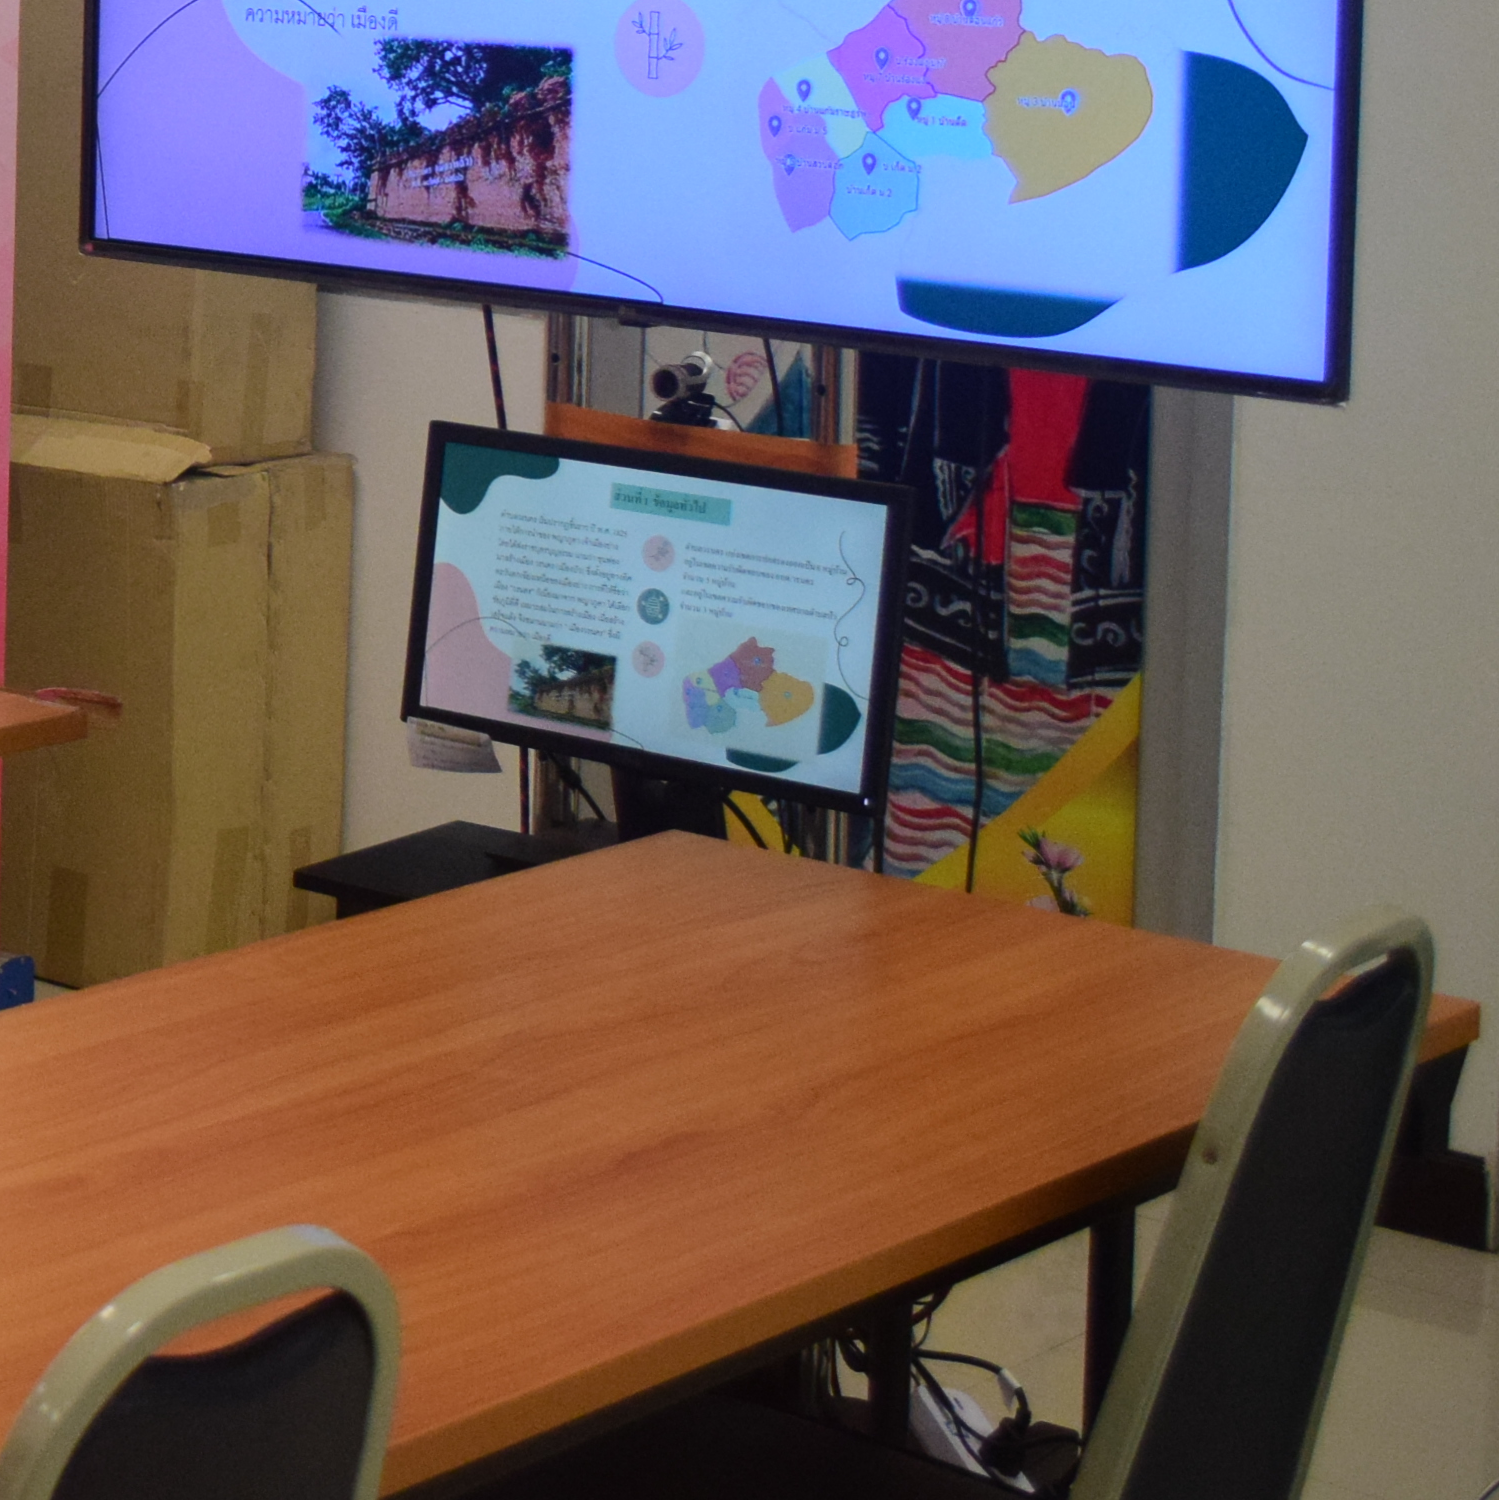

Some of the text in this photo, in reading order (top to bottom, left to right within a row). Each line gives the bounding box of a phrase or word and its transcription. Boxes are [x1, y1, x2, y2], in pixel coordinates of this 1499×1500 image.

[246, 5, 399, 31] ความหมายว่า เมืองดี
